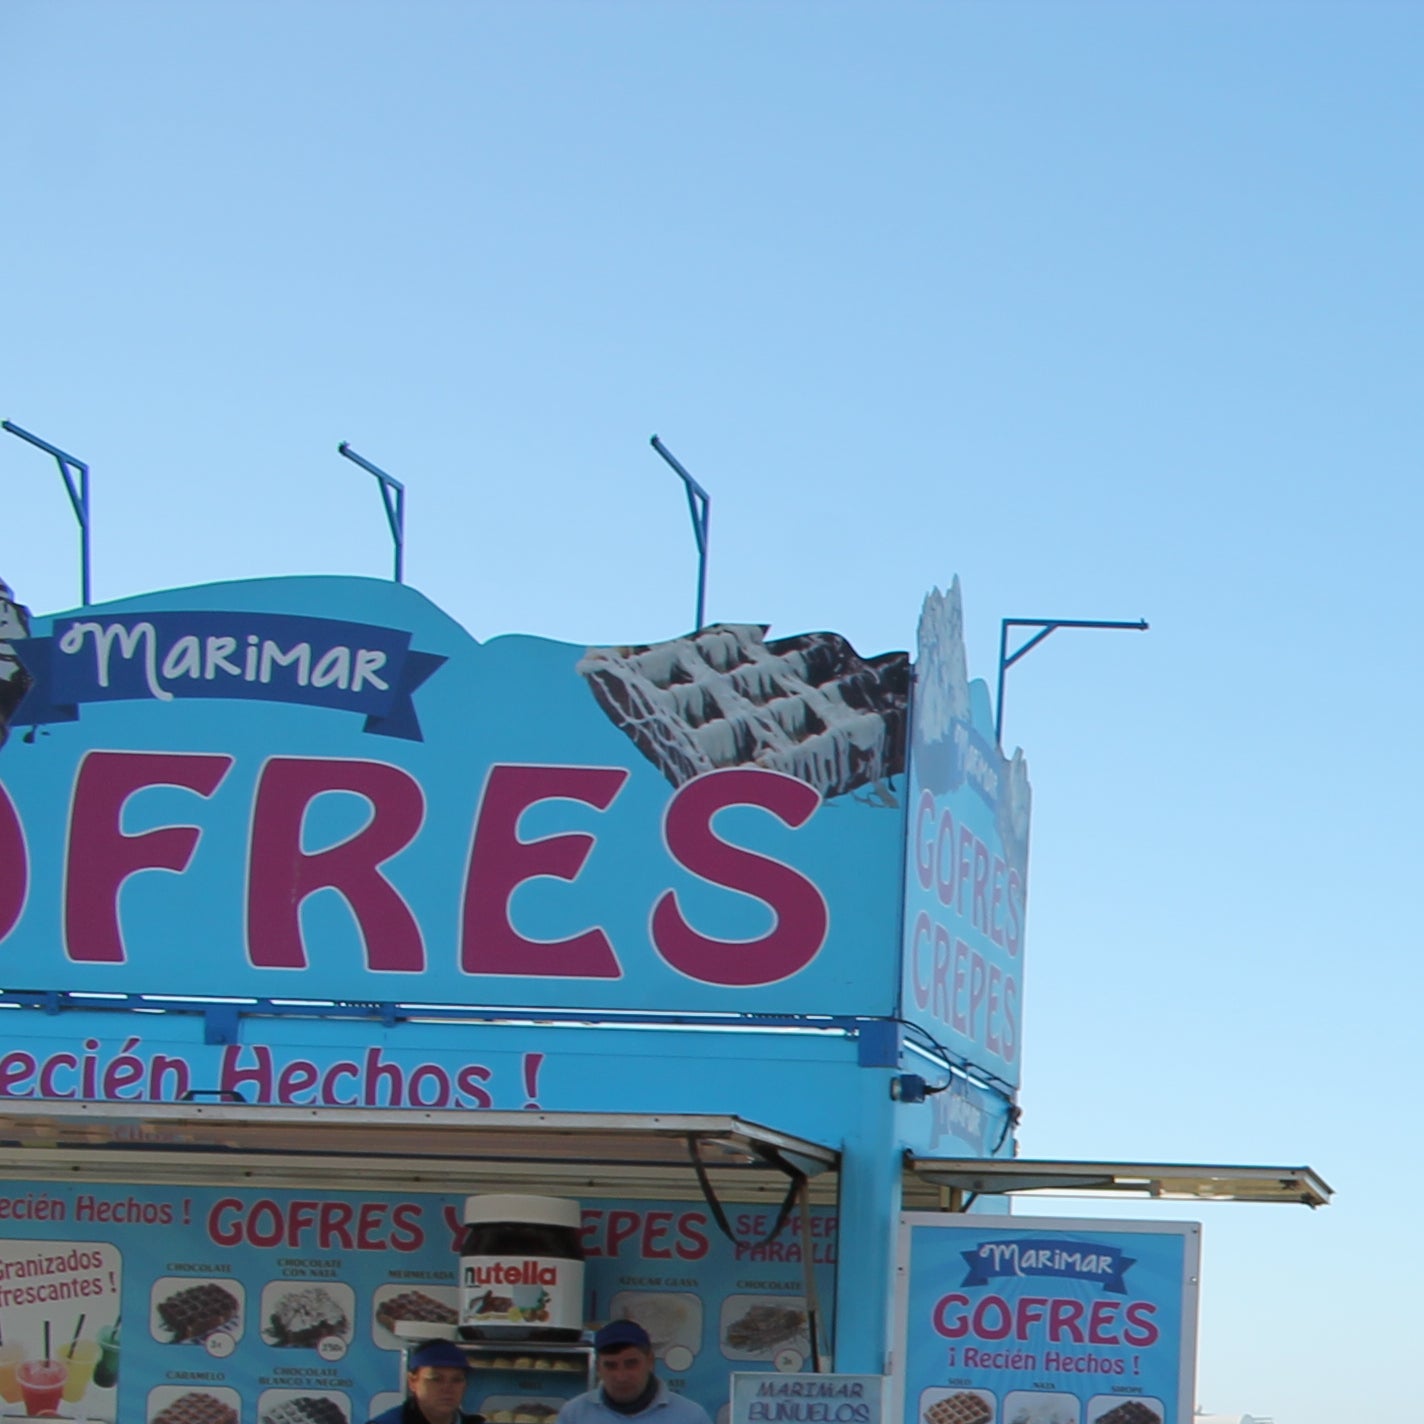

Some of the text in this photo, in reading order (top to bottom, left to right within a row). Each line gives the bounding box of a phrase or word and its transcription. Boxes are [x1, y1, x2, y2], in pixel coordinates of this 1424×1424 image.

[0, 749, 830, 988] FRES
[916, 788, 1022, 958] GOFRES
[911, 911, 1018, 1065] CREPES
[220, 1045, 494, 1110] Hechos
[76, 1195, 175, 1225] Hechos
[183, 1198, 193, 1225] !
[207, 1197, 426, 1253] GOFRES
[735, 1214, 768, 1236] SE
[277, 1257, 342, 1268] CHOCOLATE
[734, 1239, 802, 1264] PARA
[166, 1262, 233, 1274] CHOCOLATE
[464, 1260, 558, 1287] nutella
[932, 1292, 1160, 1348] GOFRES
[963, 1347, 1037, 1371] Recién
[1044, 1349, 1125, 1375] Hechos
[1133, 1355, 1141, 1376] !
[755, 1381, 864, 1398] MARIMAR
[748, 1399, 871, 1423] BUÑUELOS
